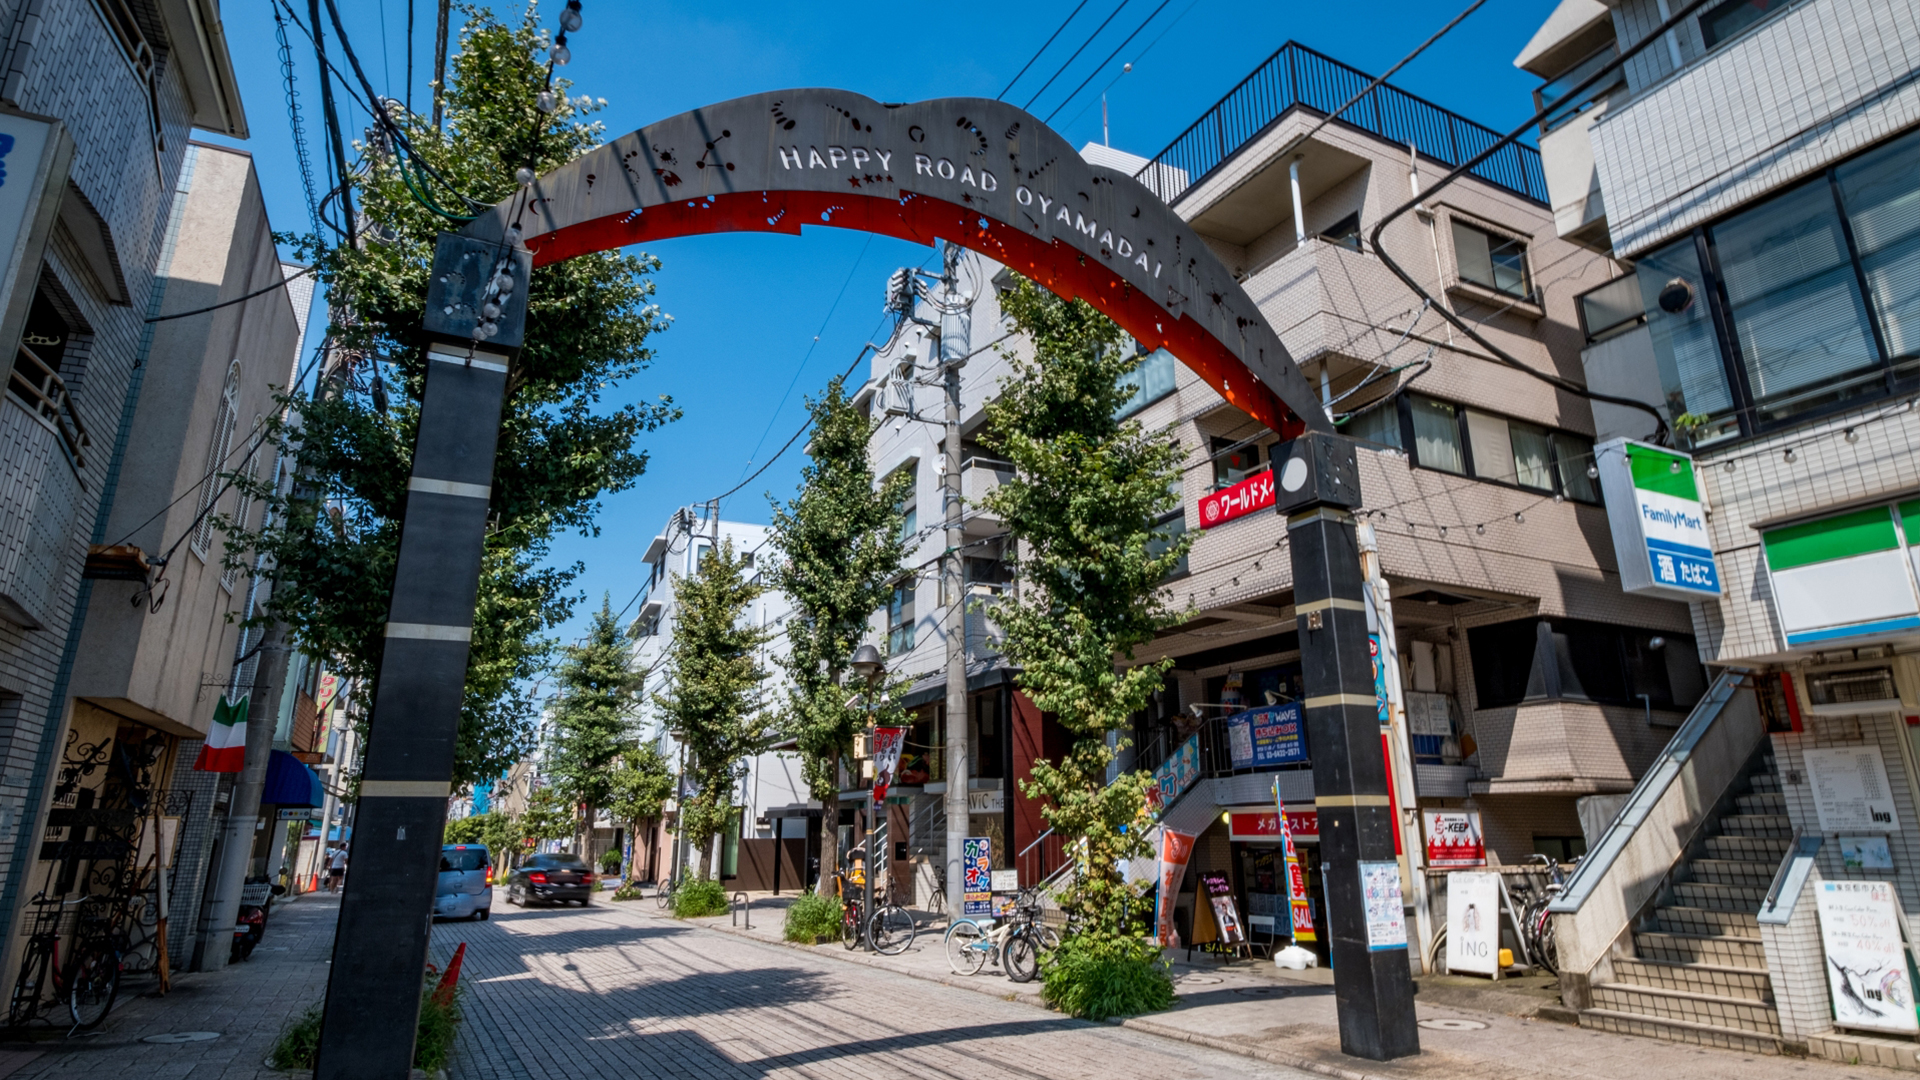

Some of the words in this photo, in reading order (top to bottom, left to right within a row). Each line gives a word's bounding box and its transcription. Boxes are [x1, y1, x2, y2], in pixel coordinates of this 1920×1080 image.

[779, 145, 893, 171] HAPPY
[914, 152, 998, 192] ROAD
[1015, 185, 1163, 279] OYAMADAI
[1642, 504, 1702, 531] FamilyMart
[1657, 553, 1677, 583] 酒
[1680, 560, 1713, 586] たばこ
[1275, 709, 1297, 722] WAVE
[1258, 817, 1319, 831] メガストア
[1293, 907, 1314, 929] SAL
[1850, 914, 1877, 927] 50%
[1856, 939, 1881, 951] 40%
